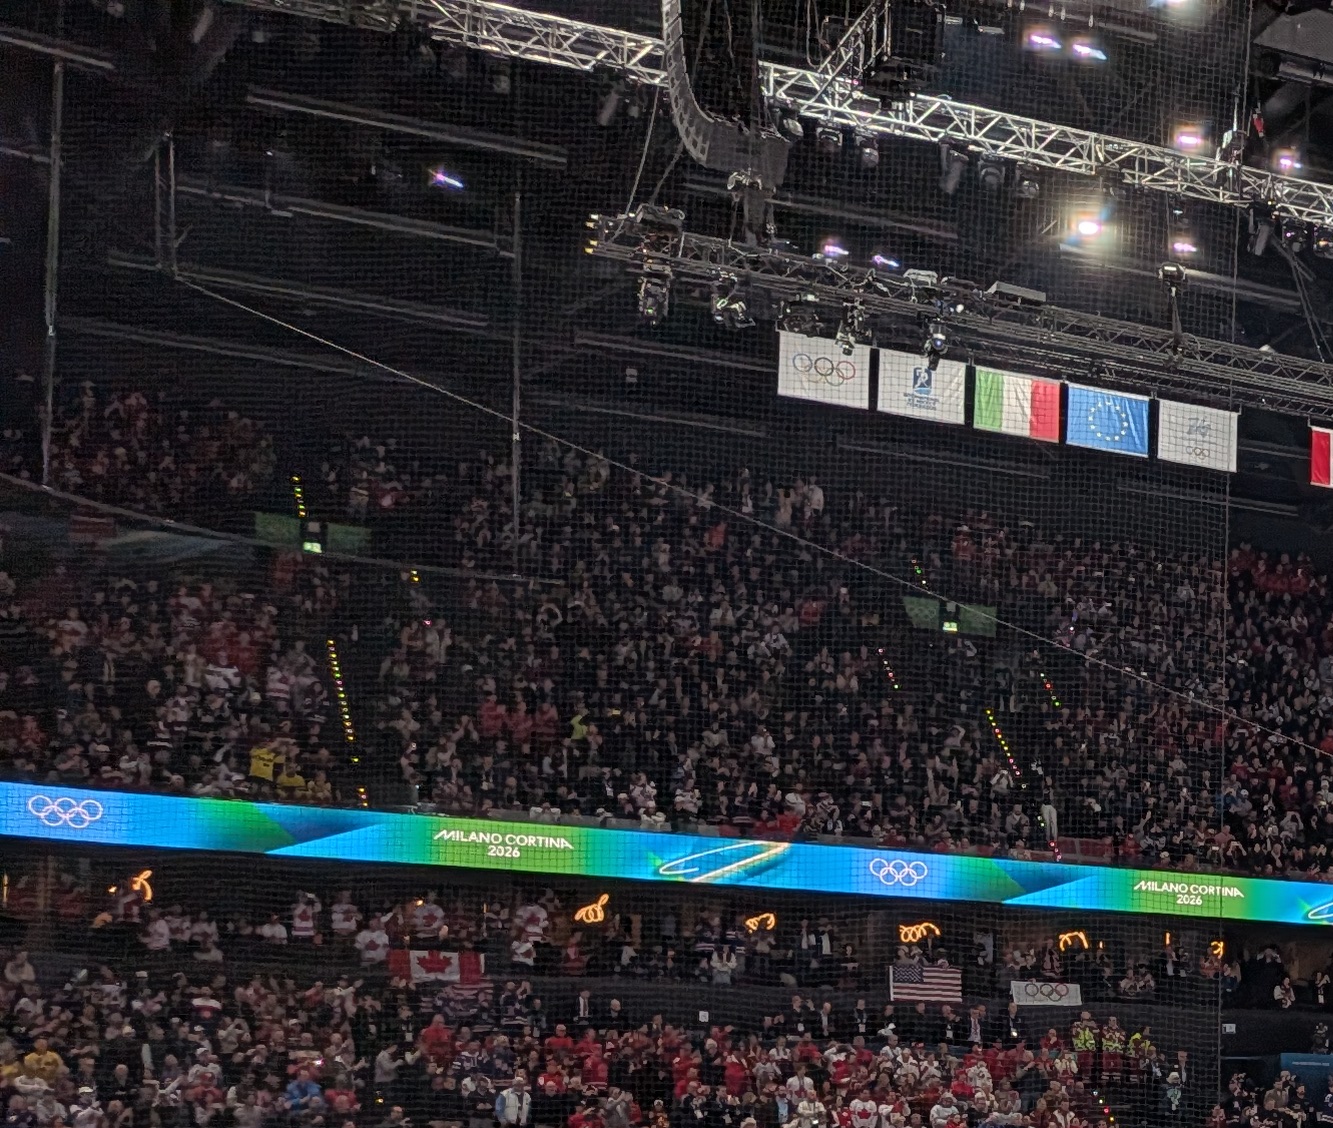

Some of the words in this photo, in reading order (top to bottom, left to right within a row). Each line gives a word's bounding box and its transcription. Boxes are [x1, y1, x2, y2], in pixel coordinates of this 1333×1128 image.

[433, 829, 502, 845] MILANO
[505, 834, 575, 850] CORTINA
[487, 845, 521, 858] 2026
[1133, 880, 1189, 894] MILANO
[1190, 884, 1245, 898] CORTINA
[1176, 894, 1203, 906] 2026
